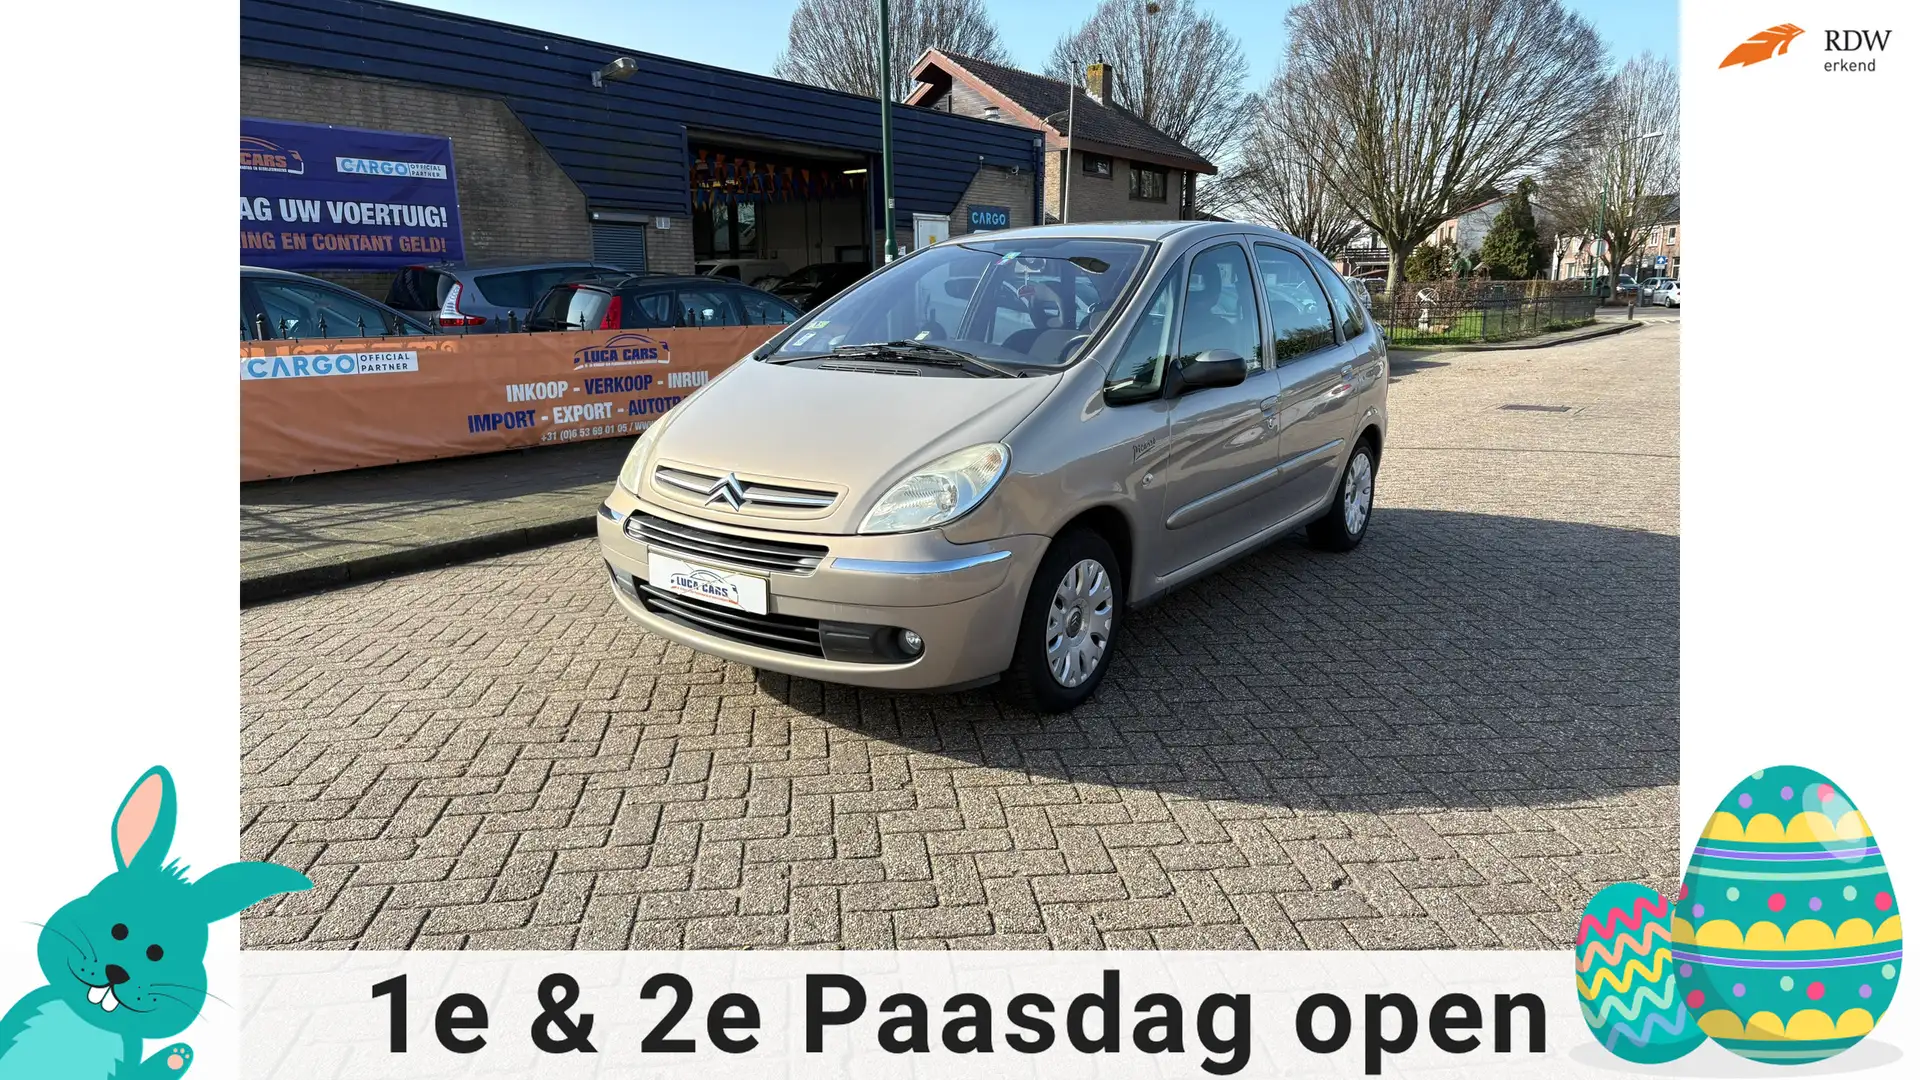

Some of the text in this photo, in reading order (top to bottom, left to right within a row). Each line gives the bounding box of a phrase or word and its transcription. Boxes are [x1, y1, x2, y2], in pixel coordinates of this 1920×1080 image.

[240, 152, 287, 168] CARS
[341, 159, 408, 175] CARGO
[279, 198, 321, 223] UW
[325, 201, 448, 228] VOERTUIG!
[971, 211, 1006, 226] CARGO
[281, 232, 307, 250] EN
[312, 233, 394, 251] CONTANT
[399, 236, 447, 253] GELD!
[360, 353, 410, 362] OFFICIAL
[584, 348, 658, 363] LUCA CARS
[247, 354, 355, 378] CARGO
[361, 363, 409, 372] PARTNER
[506, 380, 568, 402] INKOOP
[584, 374, 653, 395] VERKOOP
[467, 409, 536, 433] IMPORT
[553, 402, 613, 424] EXPORT
[541, 431, 557, 441] +31
[560, 429, 577, 441] (0)6
[579, 427, 590, 437] 53
[592, 426, 603, 435] 69
[605, 425, 615, 434] 01
[617, 423, 628, 432] 05
[676, 576, 699, 590] LUCA
[702, 583, 729, 597] CARS
